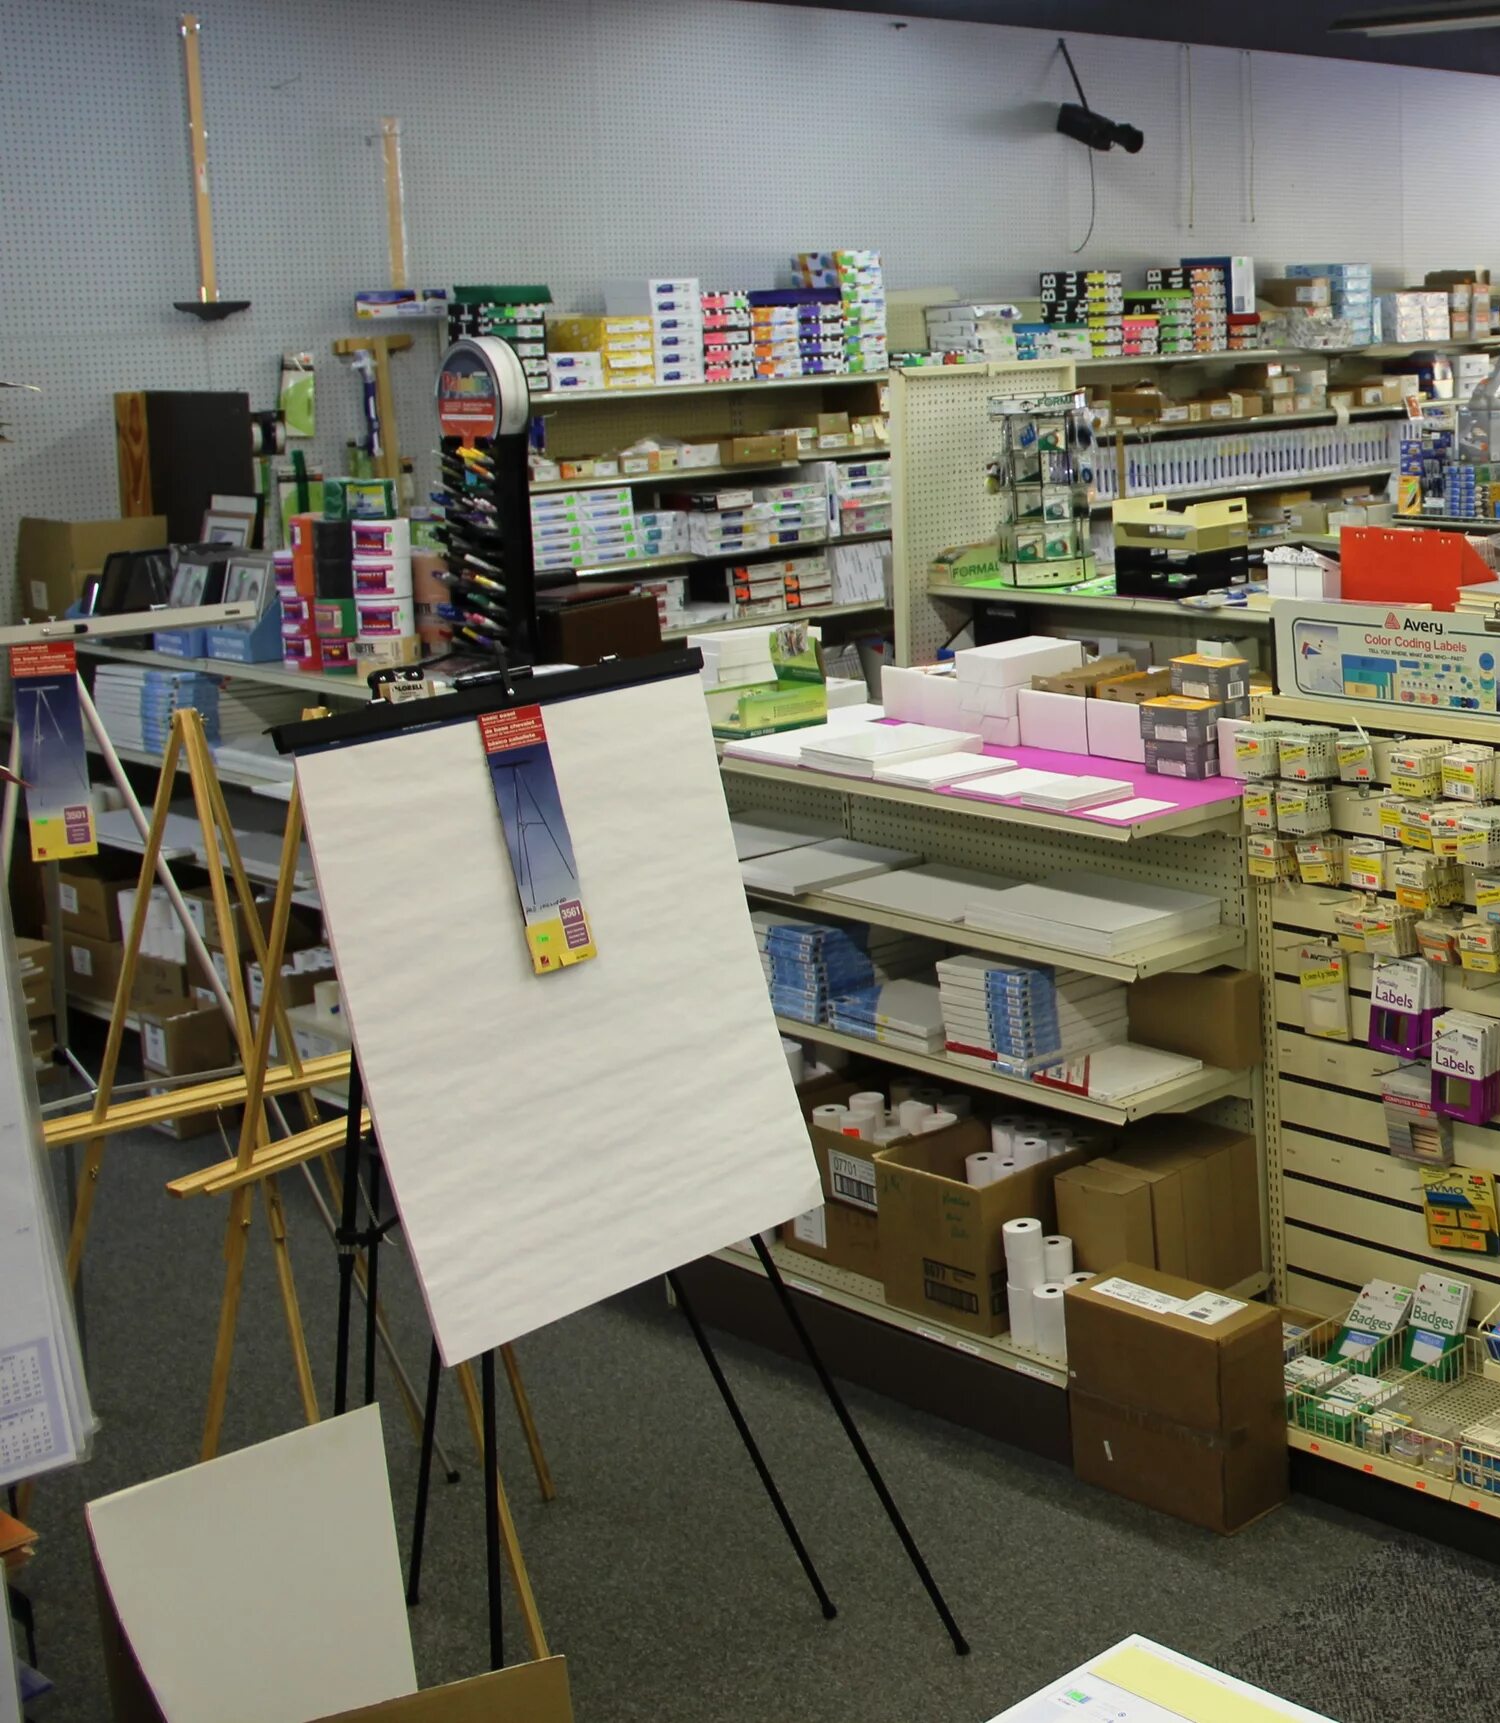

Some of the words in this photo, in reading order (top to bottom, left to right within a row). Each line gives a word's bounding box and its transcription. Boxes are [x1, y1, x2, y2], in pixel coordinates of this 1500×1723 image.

[1403, 617, 1444, 635] Avery
[1364, 634, 1393, 647] Color
[1394, 636, 1431, 651] Coding
[1433, 639, 1467, 653] Labels
[561, 905, 581, 920] 3561
[1375, 986, 1413, 1009] Labels
[1435, 1053, 1475, 1075] Labels
[833, 1156, 857, 1176] 07701
[1349, 1309, 1393, 1331] Badges
[1412, 1305, 1454, 1330] Badges
